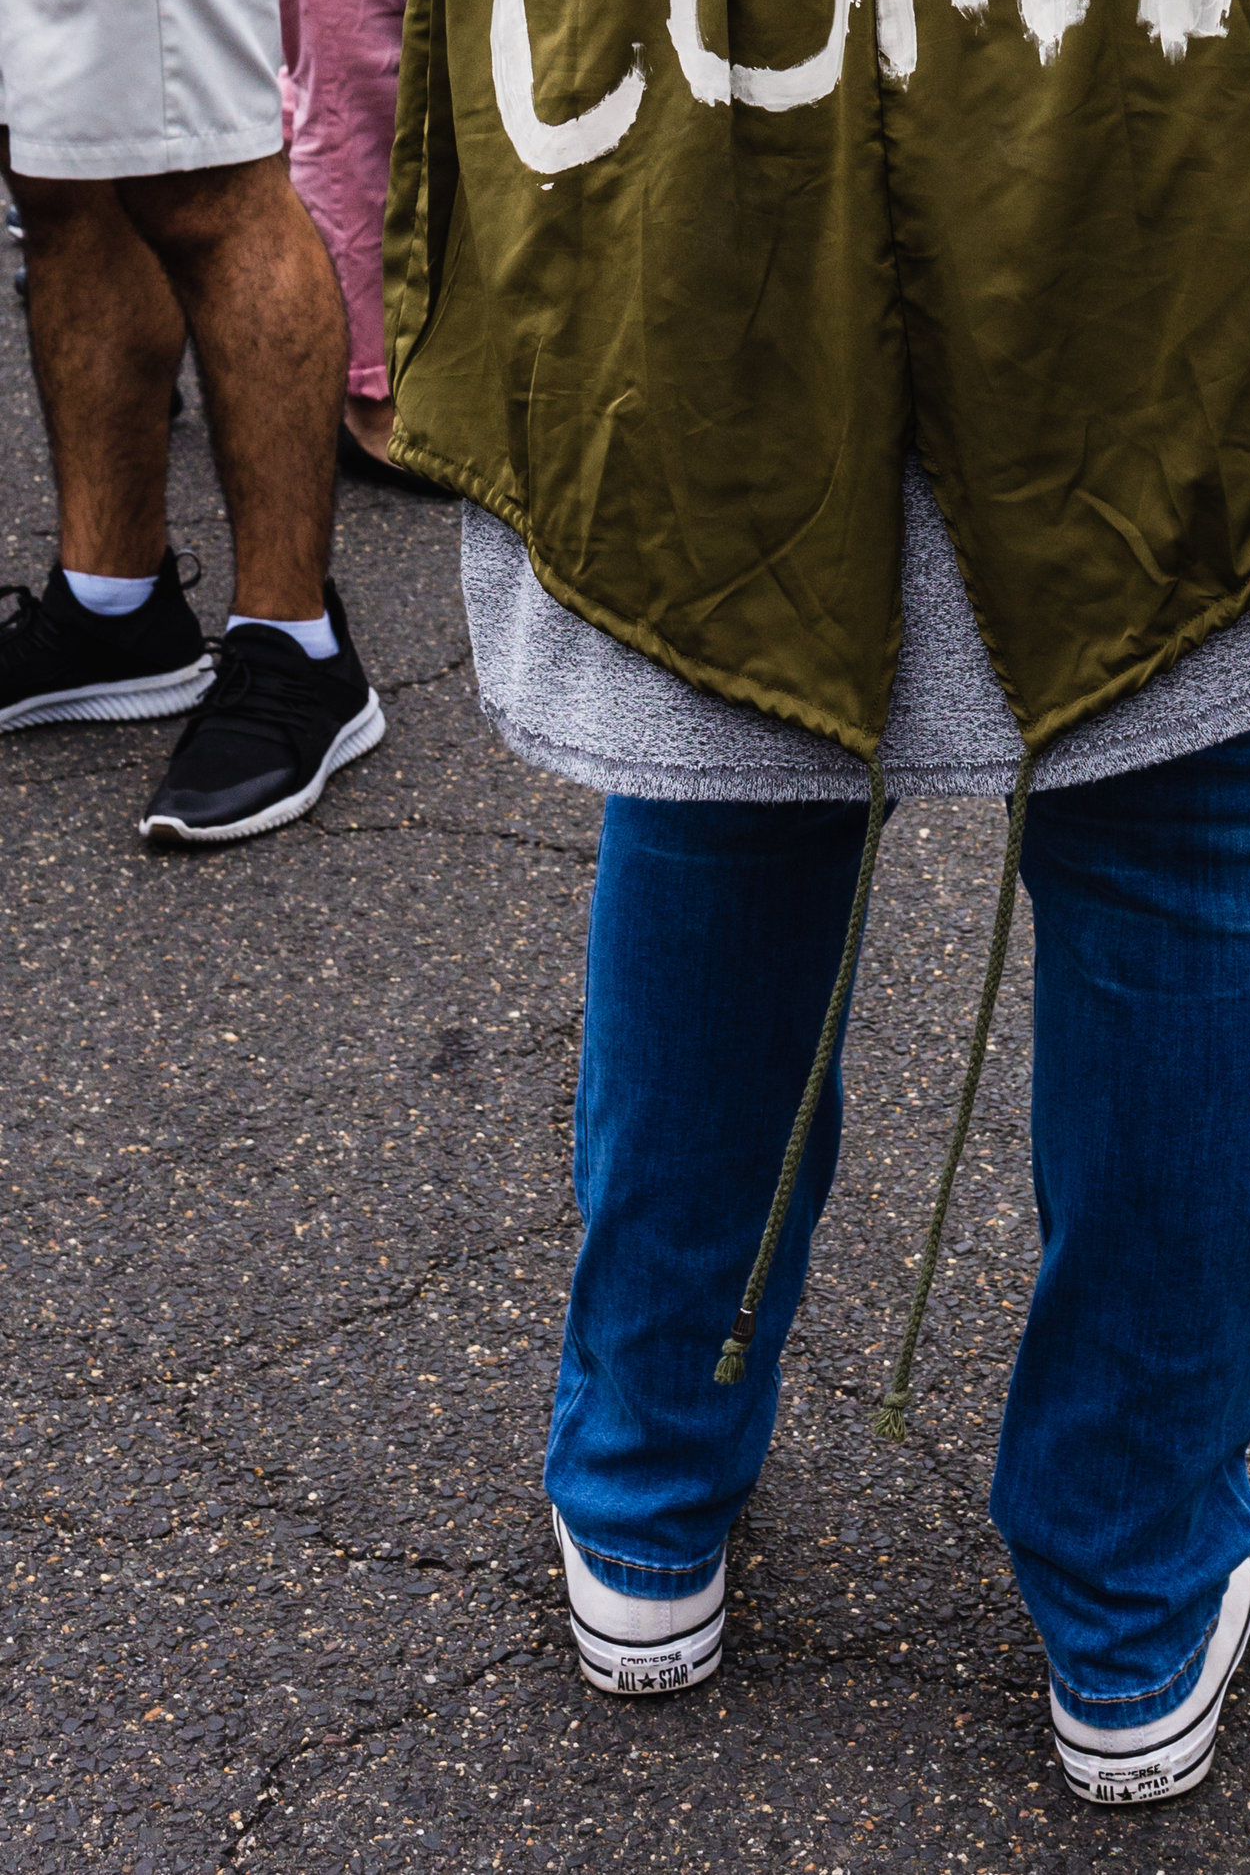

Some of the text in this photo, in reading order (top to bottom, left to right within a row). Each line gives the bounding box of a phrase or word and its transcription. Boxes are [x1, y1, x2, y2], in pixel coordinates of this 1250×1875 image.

[621, 1650, 682, 1667] CONVERSE
[617, 1663, 689, 1692] ALL STAR
